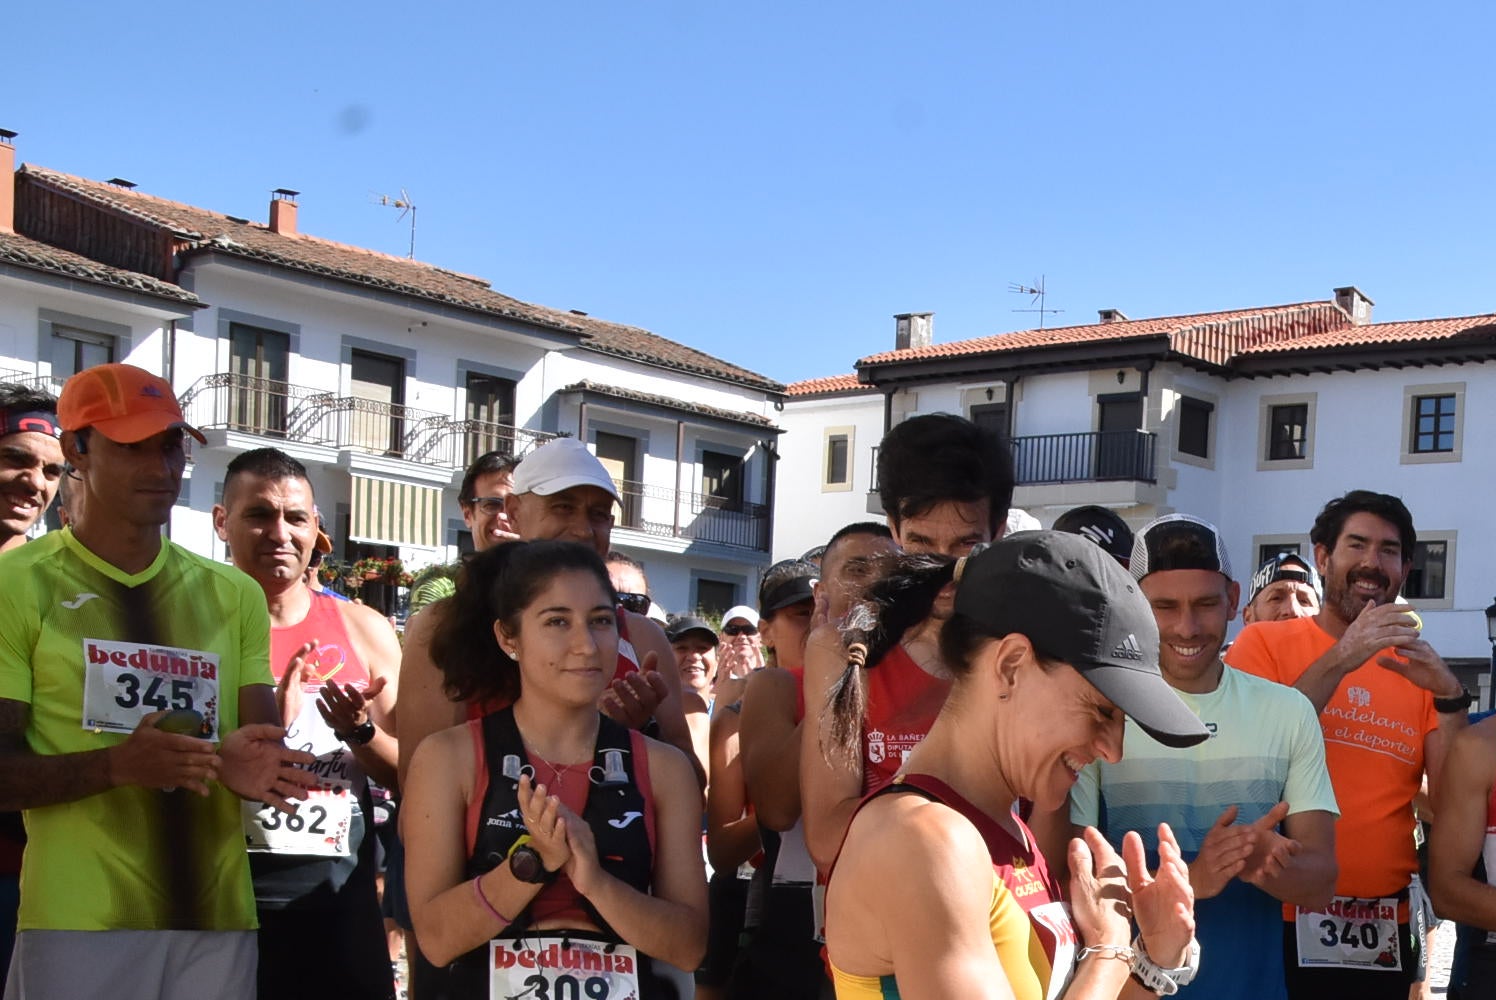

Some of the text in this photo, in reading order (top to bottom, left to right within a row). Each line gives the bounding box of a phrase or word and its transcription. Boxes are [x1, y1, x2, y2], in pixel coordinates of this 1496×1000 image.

[88, 644, 216, 680] bedunia
[115, 673, 193, 710] 345
[899, 733, 925, 741] BAÑEZ
[261, 803, 327, 834] 362
[1319, 920, 1379, 949] 340
[495, 944, 633, 974] bedunia
